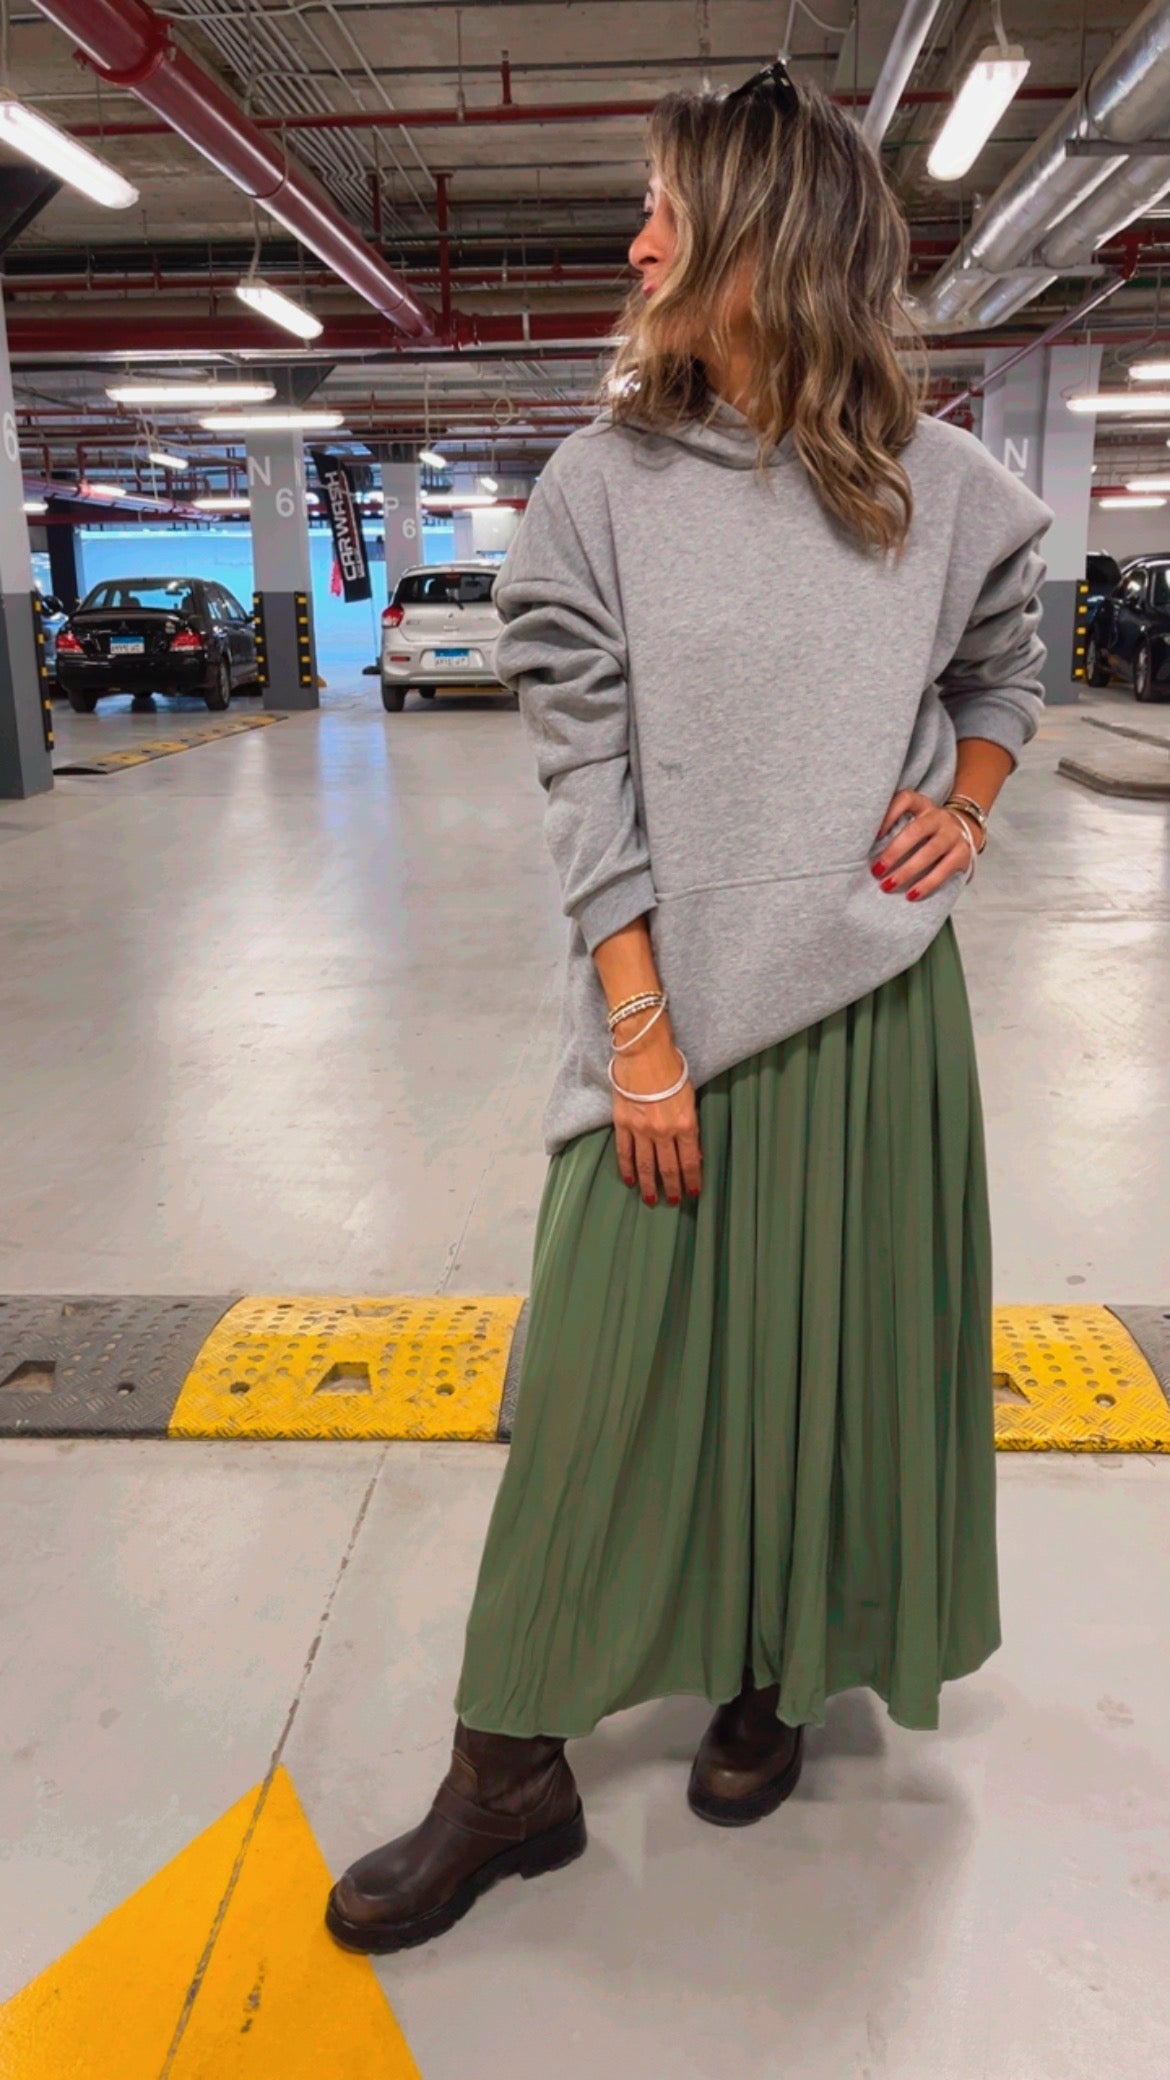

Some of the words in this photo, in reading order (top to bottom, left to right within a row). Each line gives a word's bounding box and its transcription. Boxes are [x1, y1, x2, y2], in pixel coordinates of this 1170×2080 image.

[3, 411, 18, 462] 6
[1004, 438, 1029, 470] N
[247, 456, 271, 487] N
[276, 488, 295, 517] 6
[384, 496, 399, 518] P
[402, 518, 417, 539] 6
